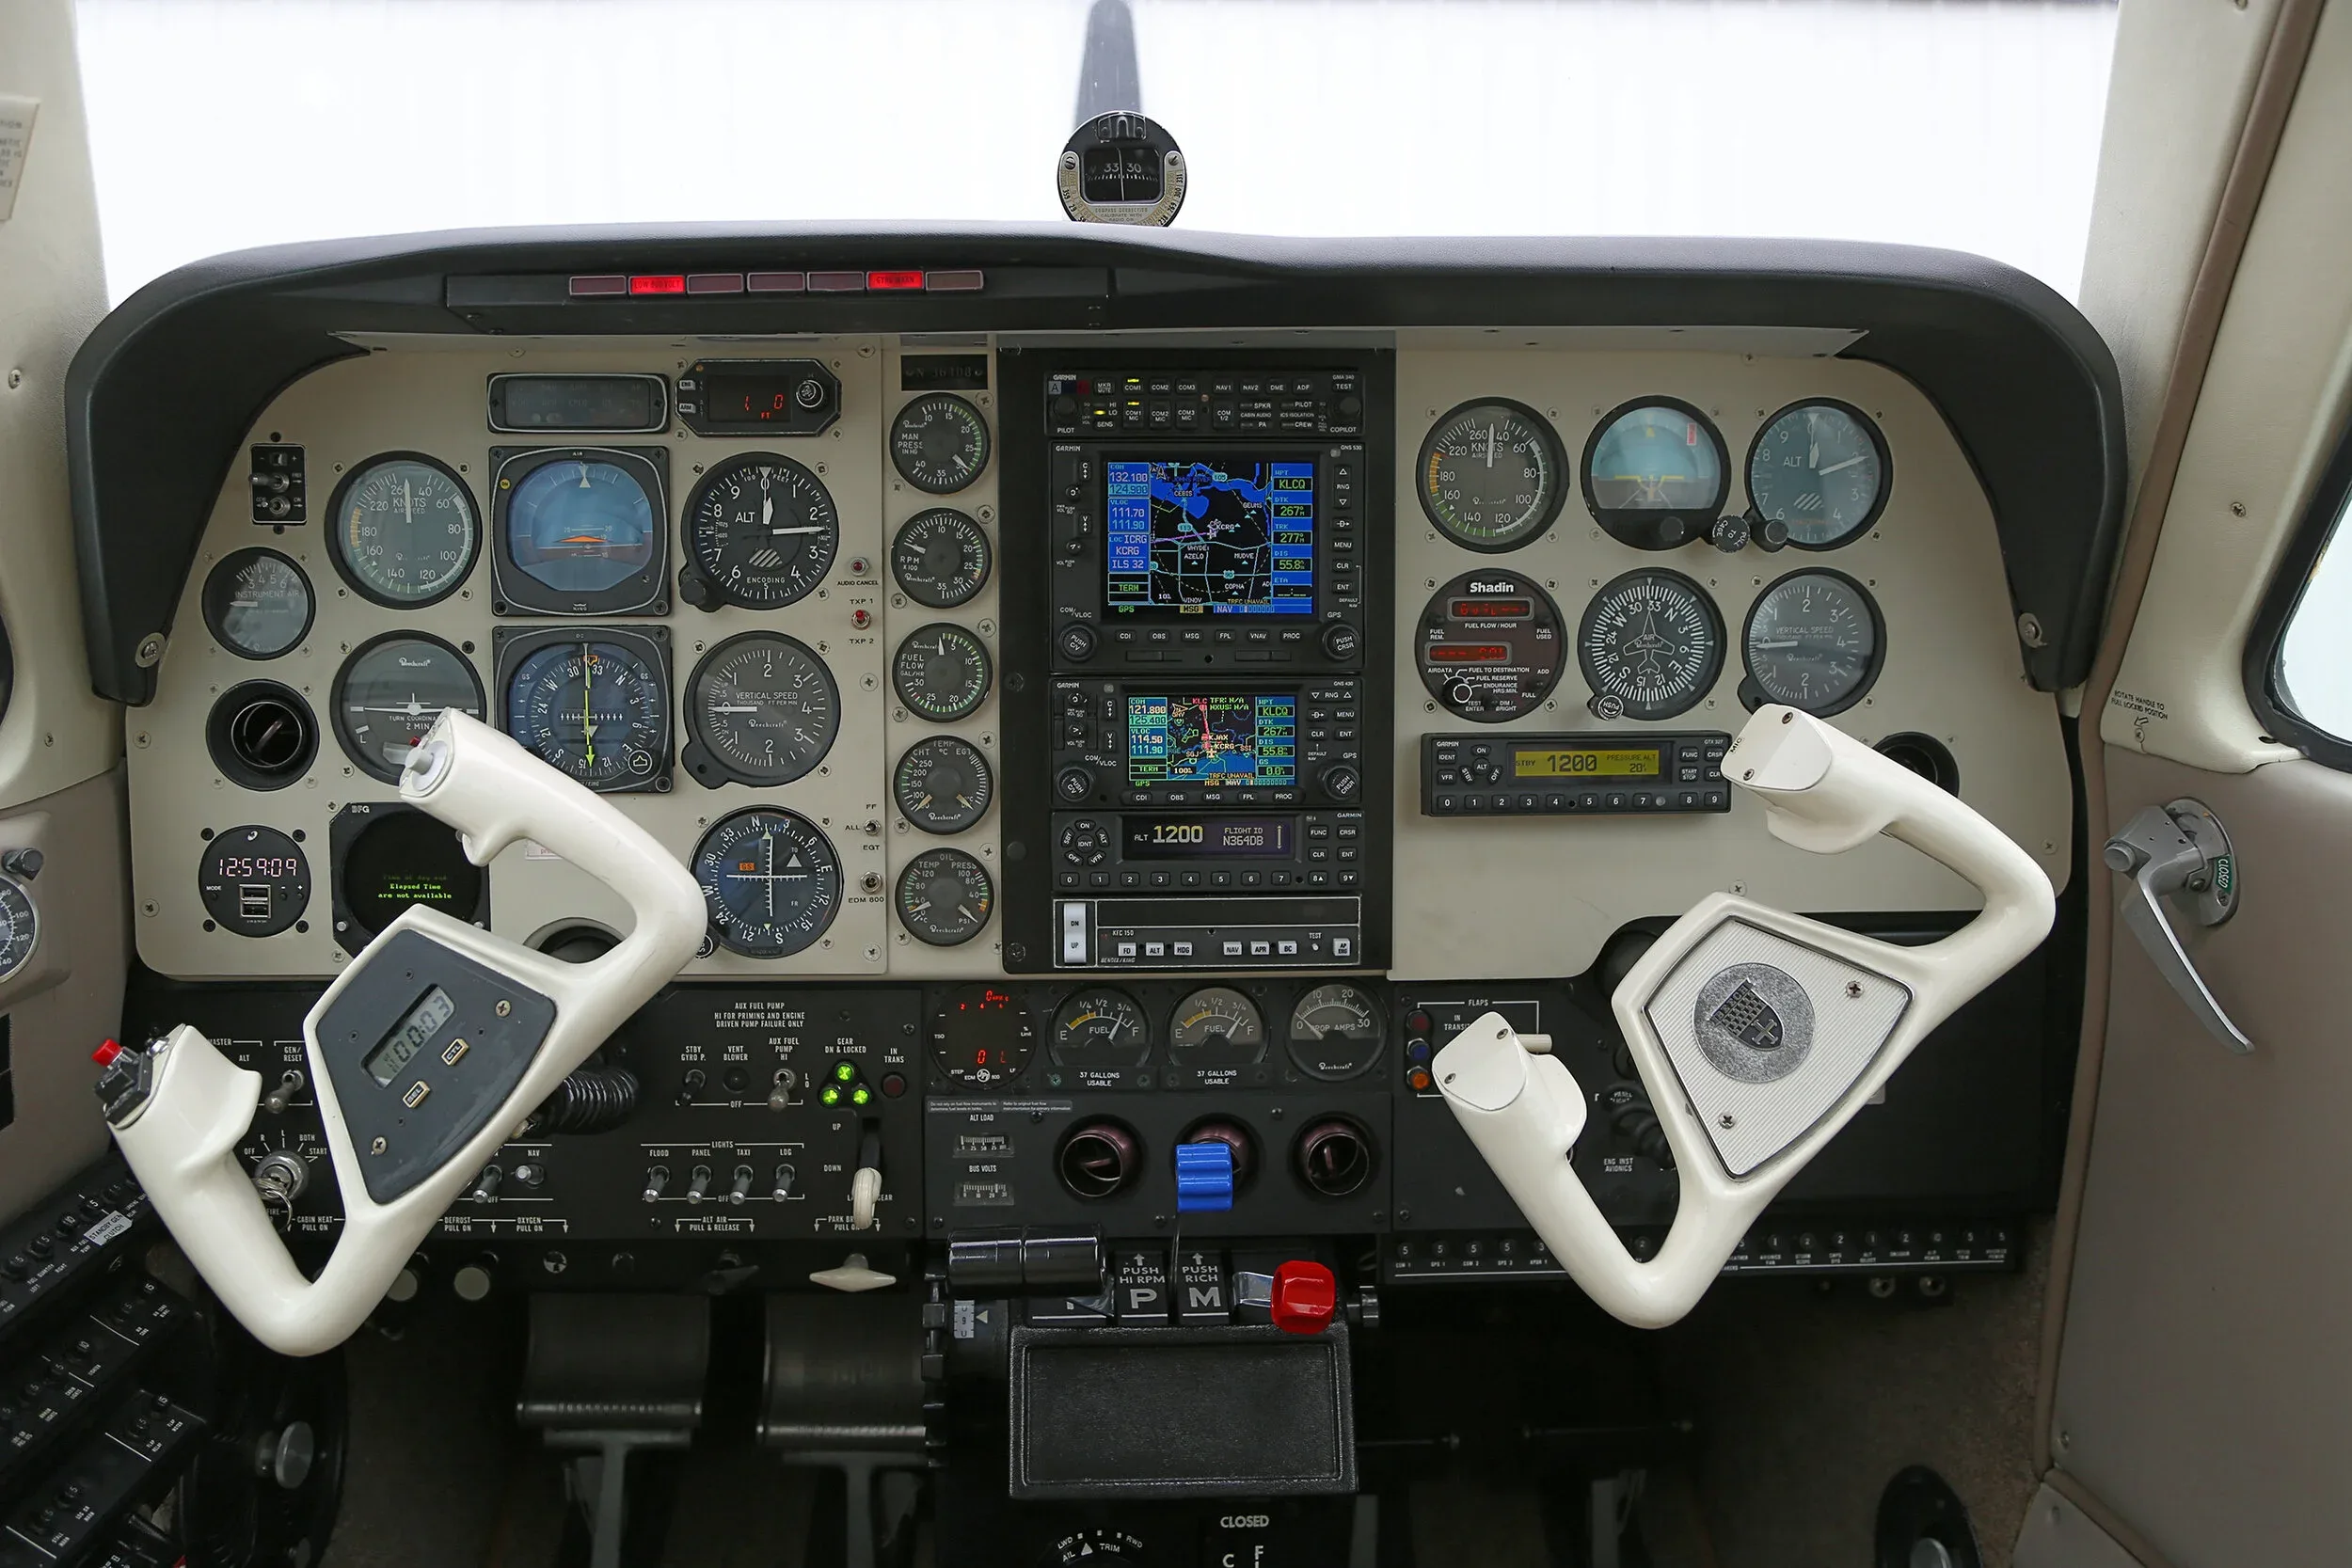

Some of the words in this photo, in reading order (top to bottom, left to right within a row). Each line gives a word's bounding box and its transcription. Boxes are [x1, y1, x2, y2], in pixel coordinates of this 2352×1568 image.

[1104, 164, 1119, 172] 33
[1127, 164, 1141, 172] 30
[1279, 480, 1305, 489] KLCQ
[1112, 508, 1144, 517] 111.70
[735, 512, 755, 523] ALT
[1112, 520, 1144, 530] 111.90
[1117, 546, 1139, 555] KCRG
[1112, 560, 1131, 568] ILS
[1133, 560, 1144, 568] 32
[419, 570, 436, 579] 120
[1470, 582, 1514, 593] Shadin
[900, 661, 924, 670] FLOW
[1263, 707, 1288, 716] KLCQ
[1547, 754, 1597, 772] 1200
[1153, 826, 1203, 842] 1200
[1223, 836, 1263, 846] N364DB
[219, 858, 297, 877] 12:59:09
[2217, 858, 2229, 888] CLOSED
[1342, 990, 1354, 998] 20
[1130, 1289, 1157, 1308] P
[1189, 1287, 1220, 1307] M
[1220, 1515, 1269, 1528] CLOSED
[1100, 1544, 1120, 1552] TRIM
